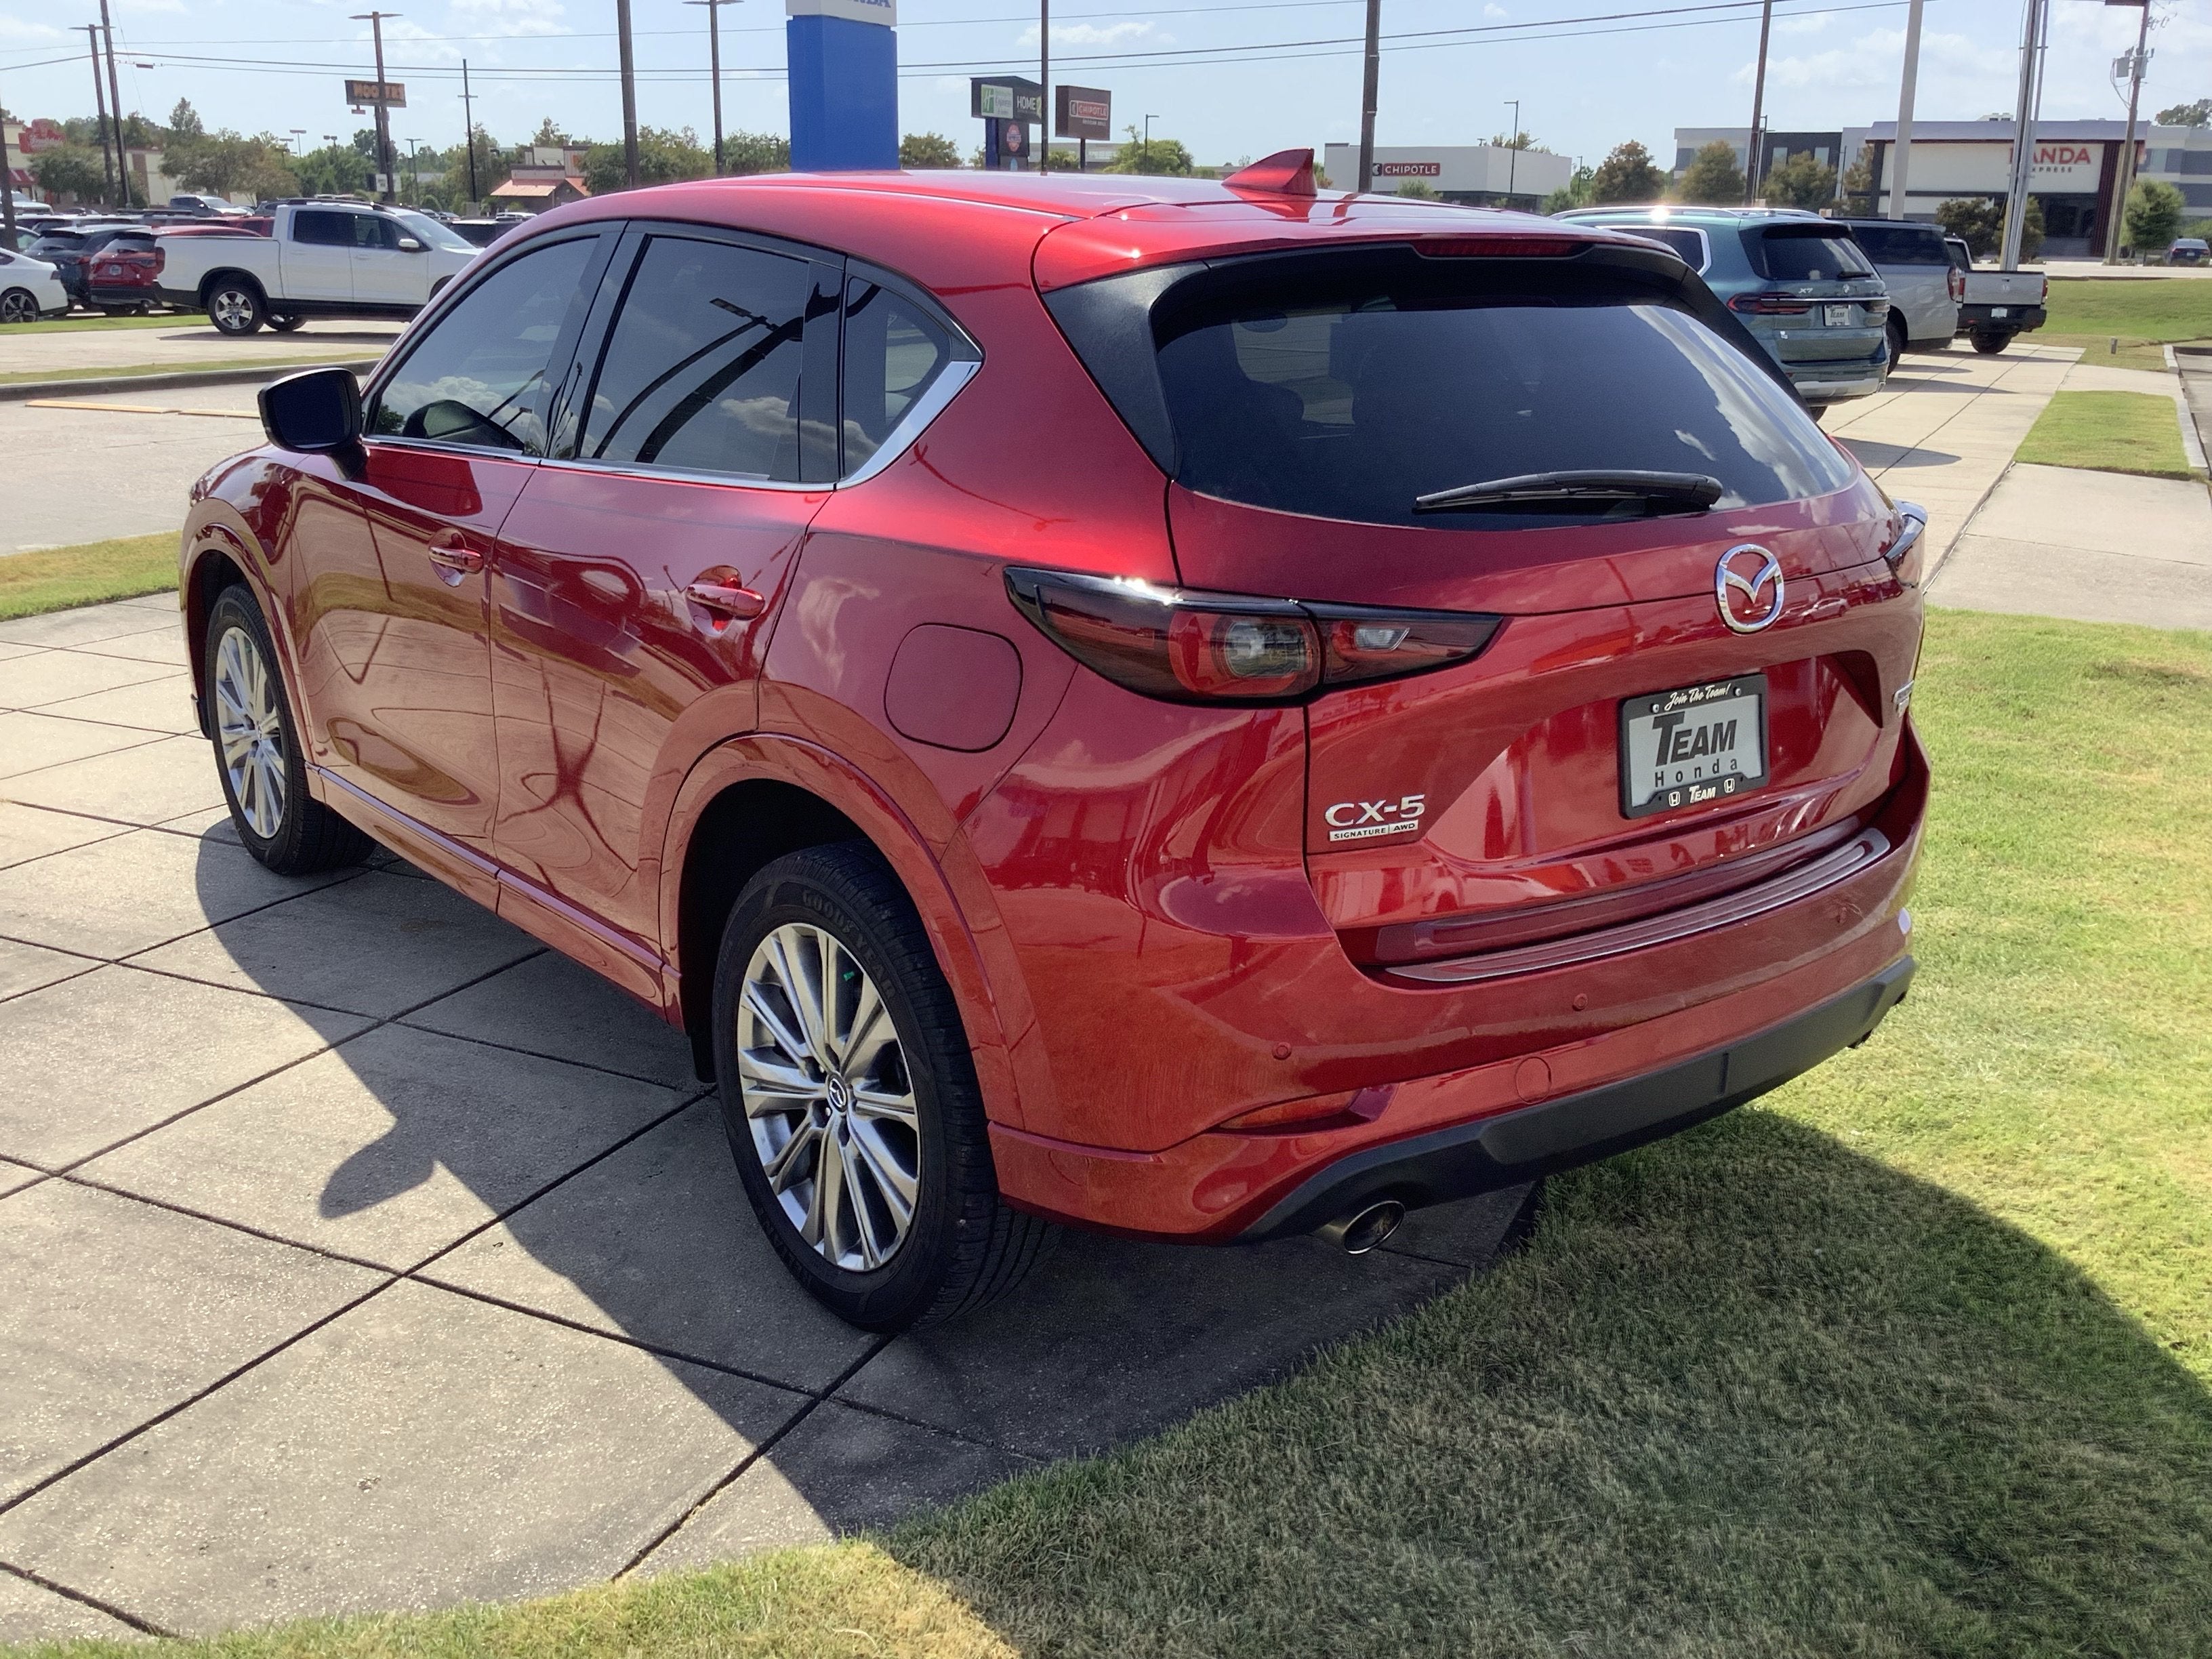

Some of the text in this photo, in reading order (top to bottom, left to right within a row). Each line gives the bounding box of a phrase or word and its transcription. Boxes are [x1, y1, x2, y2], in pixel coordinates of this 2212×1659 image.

[1079, 104, 1107, 117] CHIPOTLE
[2010, 147, 2091, 164] NDA
[1385, 165, 1437, 174] CHIPOTLE
[1664, 682, 1732, 712] Join The Team!
[1652, 711, 1738, 767] TEAM
[1654, 758, 1738, 787] Honda
[1689, 785, 1717, 804] TEAM
[1324, 794, 1426, 827] CX-5
[1333, 823, 1416, 840] SIGNATURE AWD
